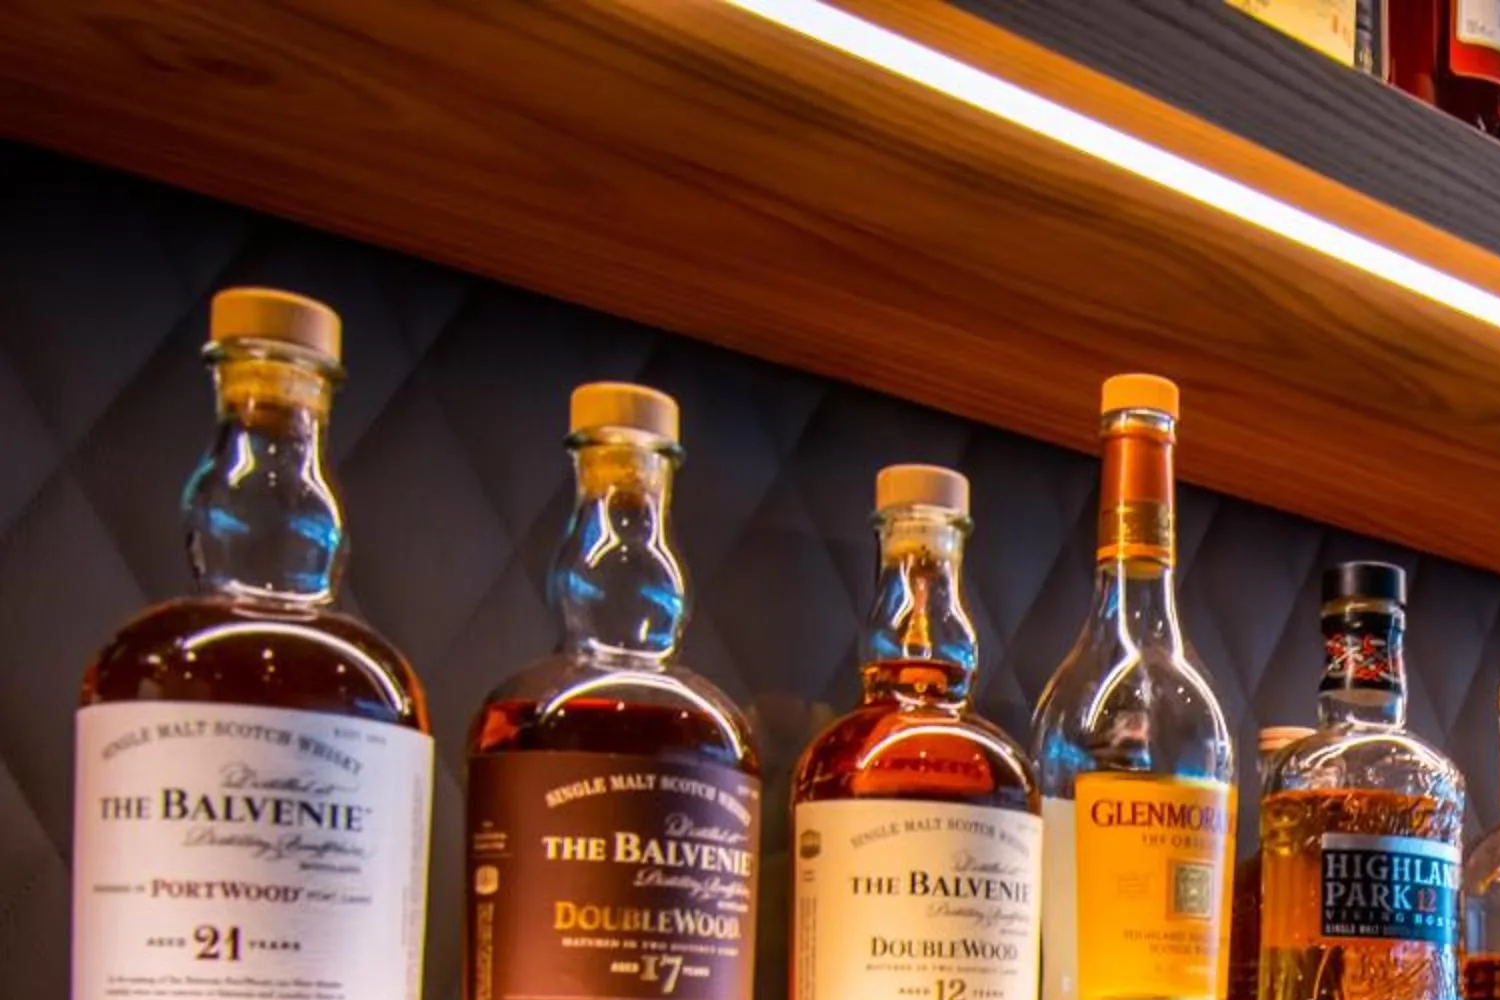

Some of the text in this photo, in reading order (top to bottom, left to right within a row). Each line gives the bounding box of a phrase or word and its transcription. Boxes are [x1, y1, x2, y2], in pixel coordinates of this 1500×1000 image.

[157, 720, 206, 741] MALT
[214, 721, 291, 747] SCOTCH
[298, 737, 363, 777] WHISKY
[100, 788, 364, 832] THE BALVENIE
[545, 774, 716, 808] SINGLE MALT SCOTCH
[851, 823, 899, 848] SINGLE
[905, 819, 941, 832] MALT
[542, 832, 752, 876] THE BALVENIE
[851, 871, 1030, 904] THE BALVENIE
[1325, 882, 1437, 913] PARK 12
[193, 924, 241, 962] 21
[640, 954, 684, 994] 17
